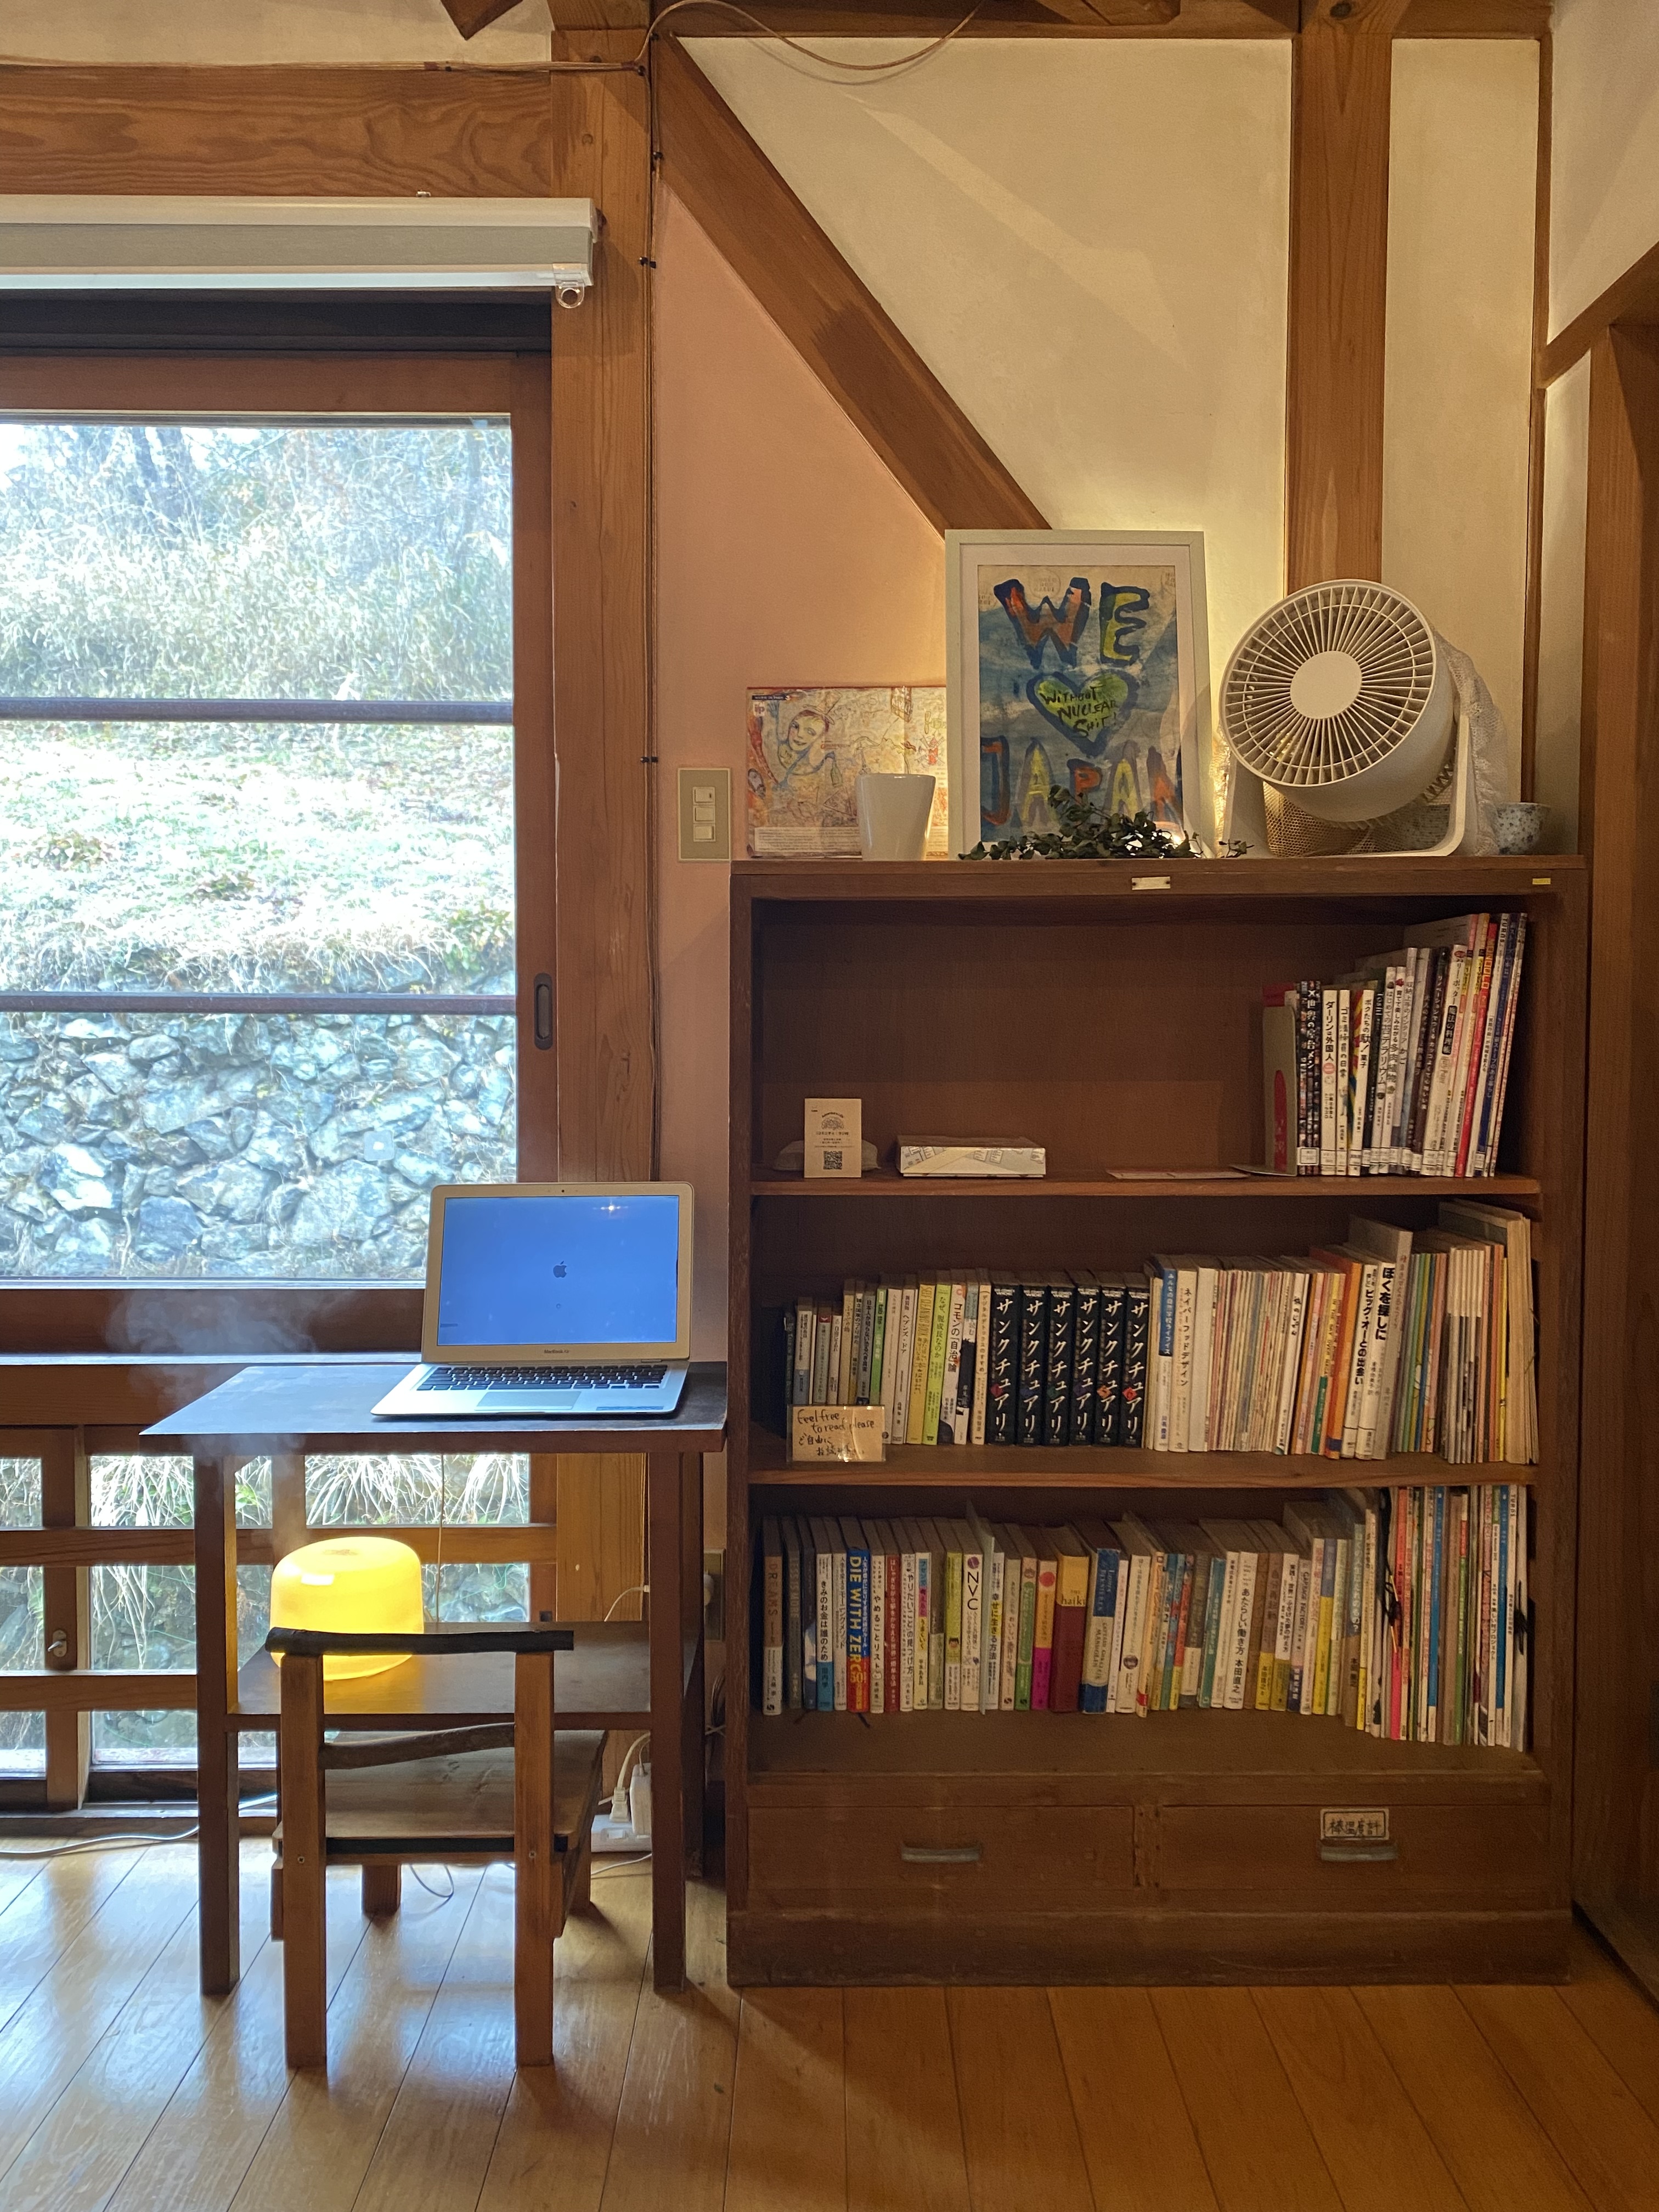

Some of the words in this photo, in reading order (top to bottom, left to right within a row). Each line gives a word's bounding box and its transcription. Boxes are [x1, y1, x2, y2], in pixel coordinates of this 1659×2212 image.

[994, 577, 1150, 669] WE
[1058, 698, 1120, 720] NUCLEAR
[980, 736, 1184, 826] JAPAN
[934, 1296, 946, 1358] なぜ、脱成長なのか
[948, 1303, 963, 1373] コモンの「自治」論
[995, 1298, 1013, 1432] サンクチュアリ
[1023, 1300, 1043, 1434] サンクチュアリ
[1076, 1298, 1097, 1430] サンクチュアリ
[1101, 1300, 1123, 1434] サンクチュアリ
[1180, 1288, 1192, 1386] ネイバーフッドデザイン
[1050, 1301, 1071, 1435] サンクチュアリ
[1126, 1302, 1148, 1435] サンクチュアリ
[811, 1423, 822, 1434] to
[819, 1409, 839, 1423] free
[849, 1556, 861, 1583] DIE
[849, 1588, 861, 1630] WITH
[967, 1571, 980, 1610] NVC
[1232, 1658, 1244, 1694] 本田直之
